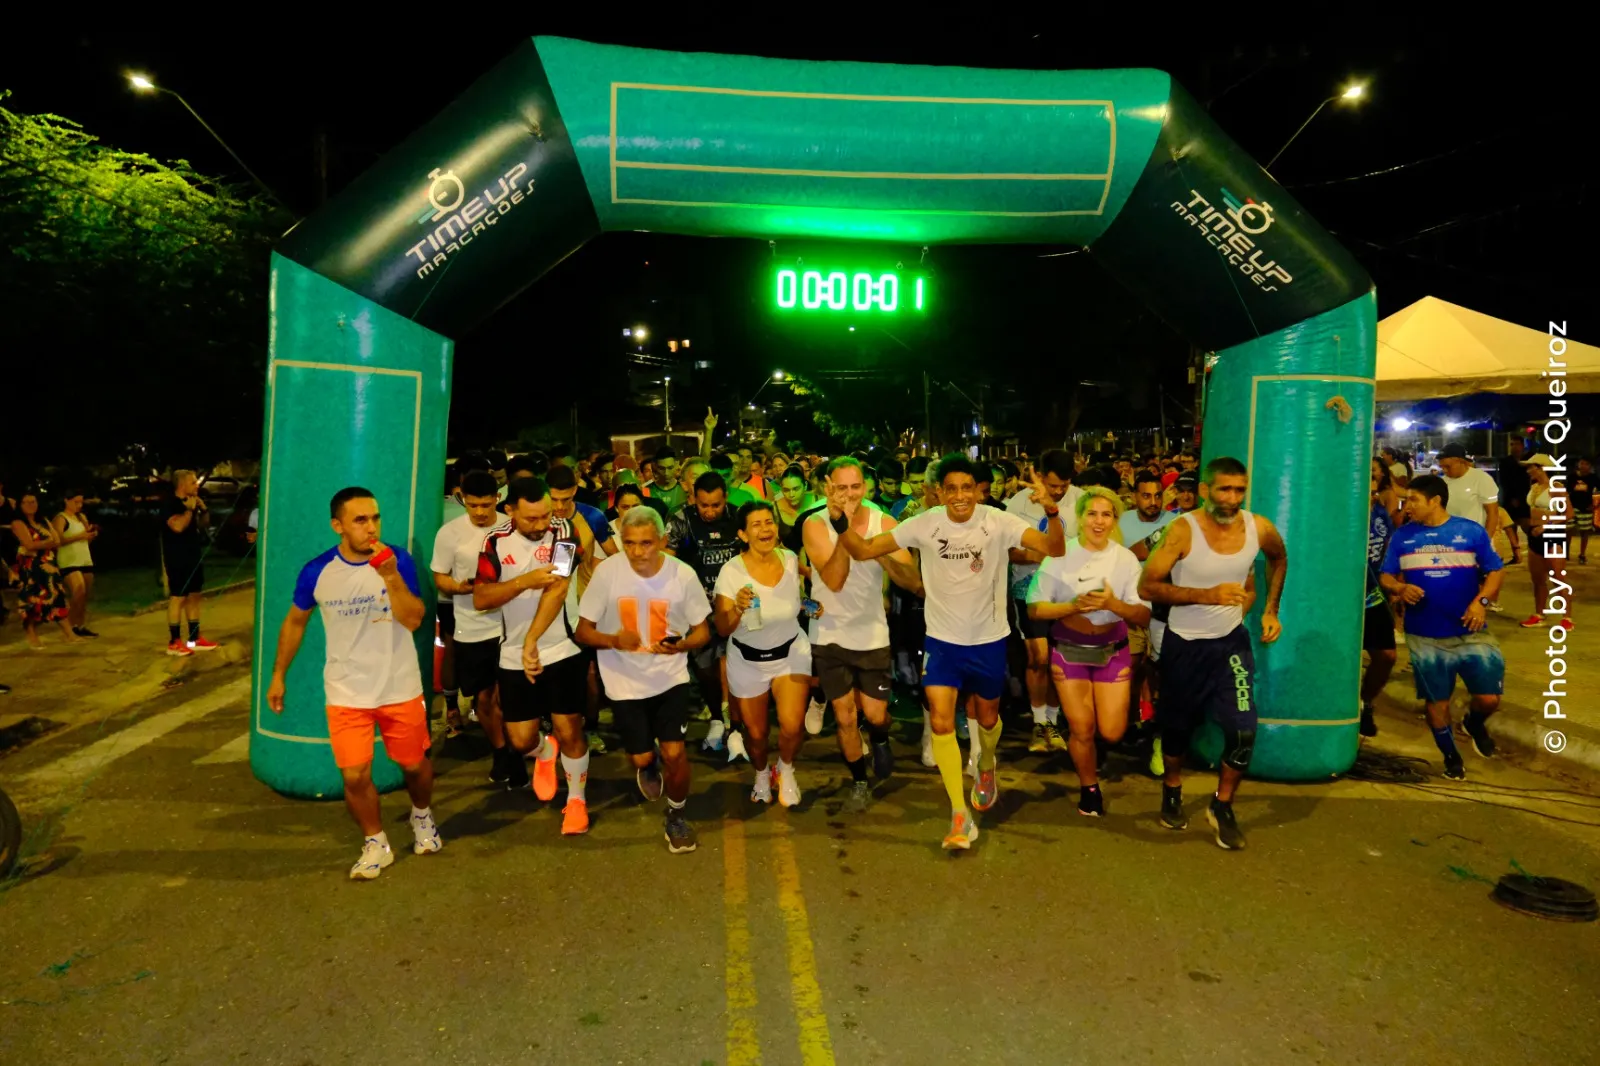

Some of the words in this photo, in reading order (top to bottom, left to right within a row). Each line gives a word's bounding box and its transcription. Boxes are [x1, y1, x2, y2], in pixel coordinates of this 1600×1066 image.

[416, 179, 536, 279] MARCAÇÕES
[1170, 201, 1278, 292] MARCAÇÕES
[1229, 654, 1250, 712] adidas
